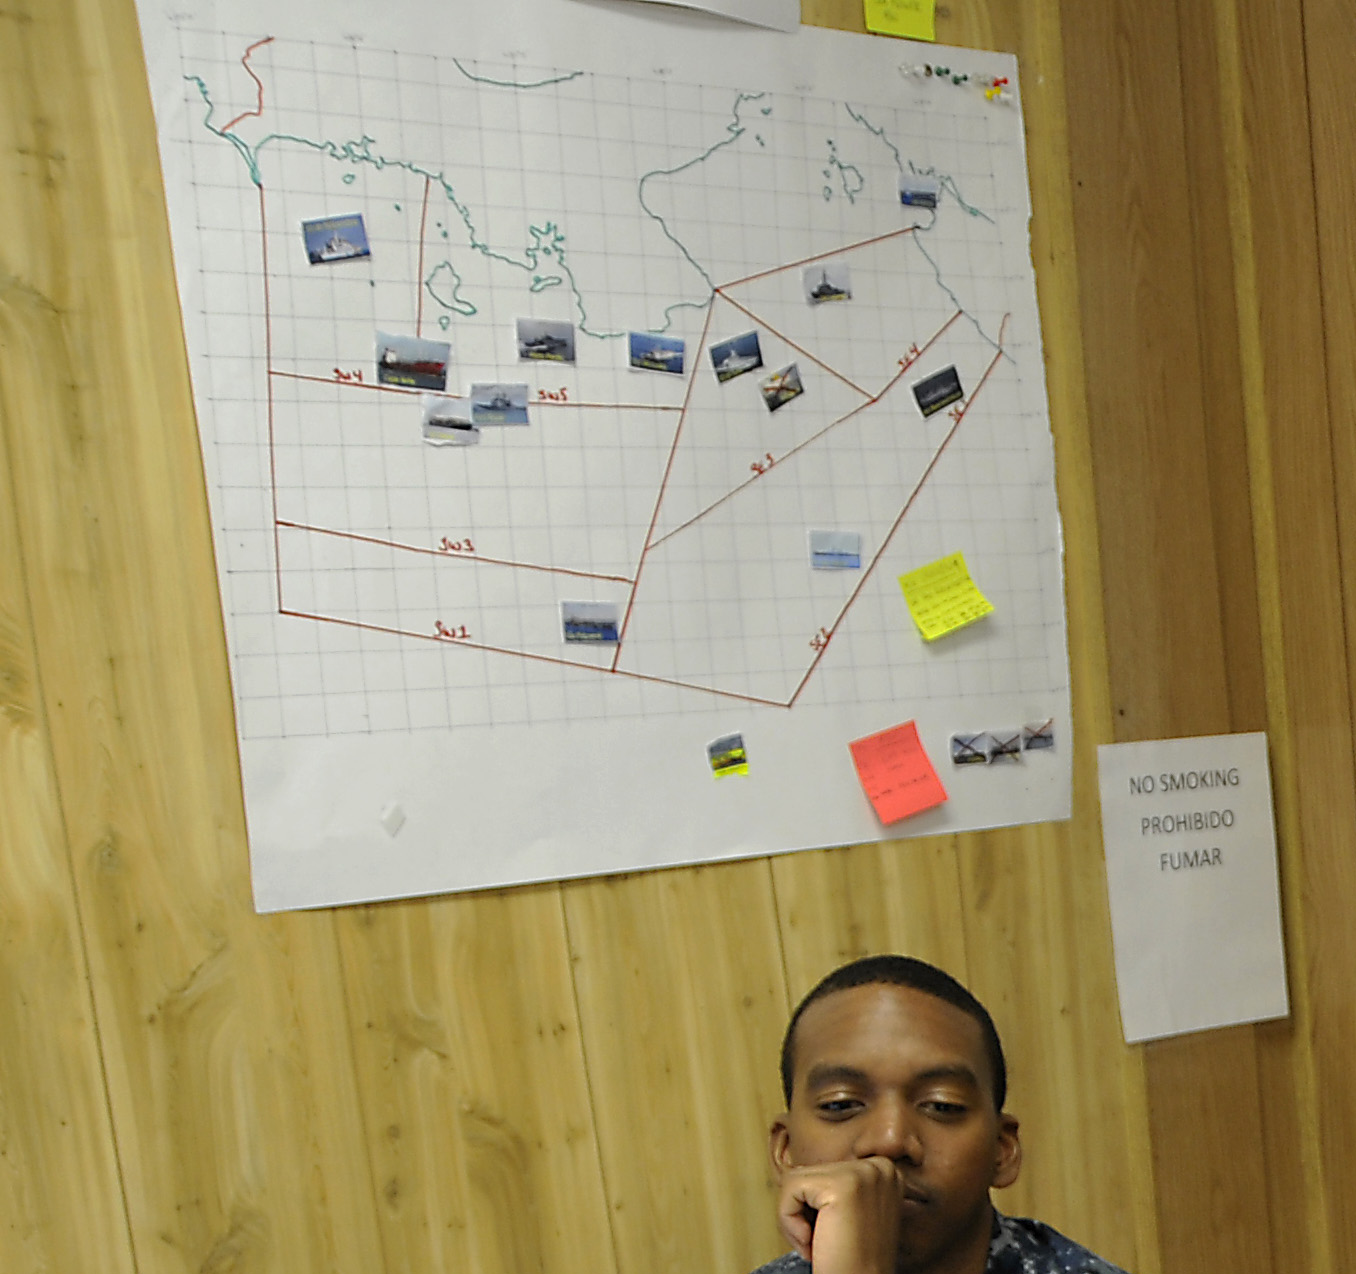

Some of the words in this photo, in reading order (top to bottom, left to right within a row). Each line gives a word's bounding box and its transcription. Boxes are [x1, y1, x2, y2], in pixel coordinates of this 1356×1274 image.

[1129, 775, 1154, 795] NO
[1159, 766, 1240, 793] SMOKING
[1141, 808, 1235, 834] PROHIBIDO
[1159, 847, 1222, 870] FUMAR
